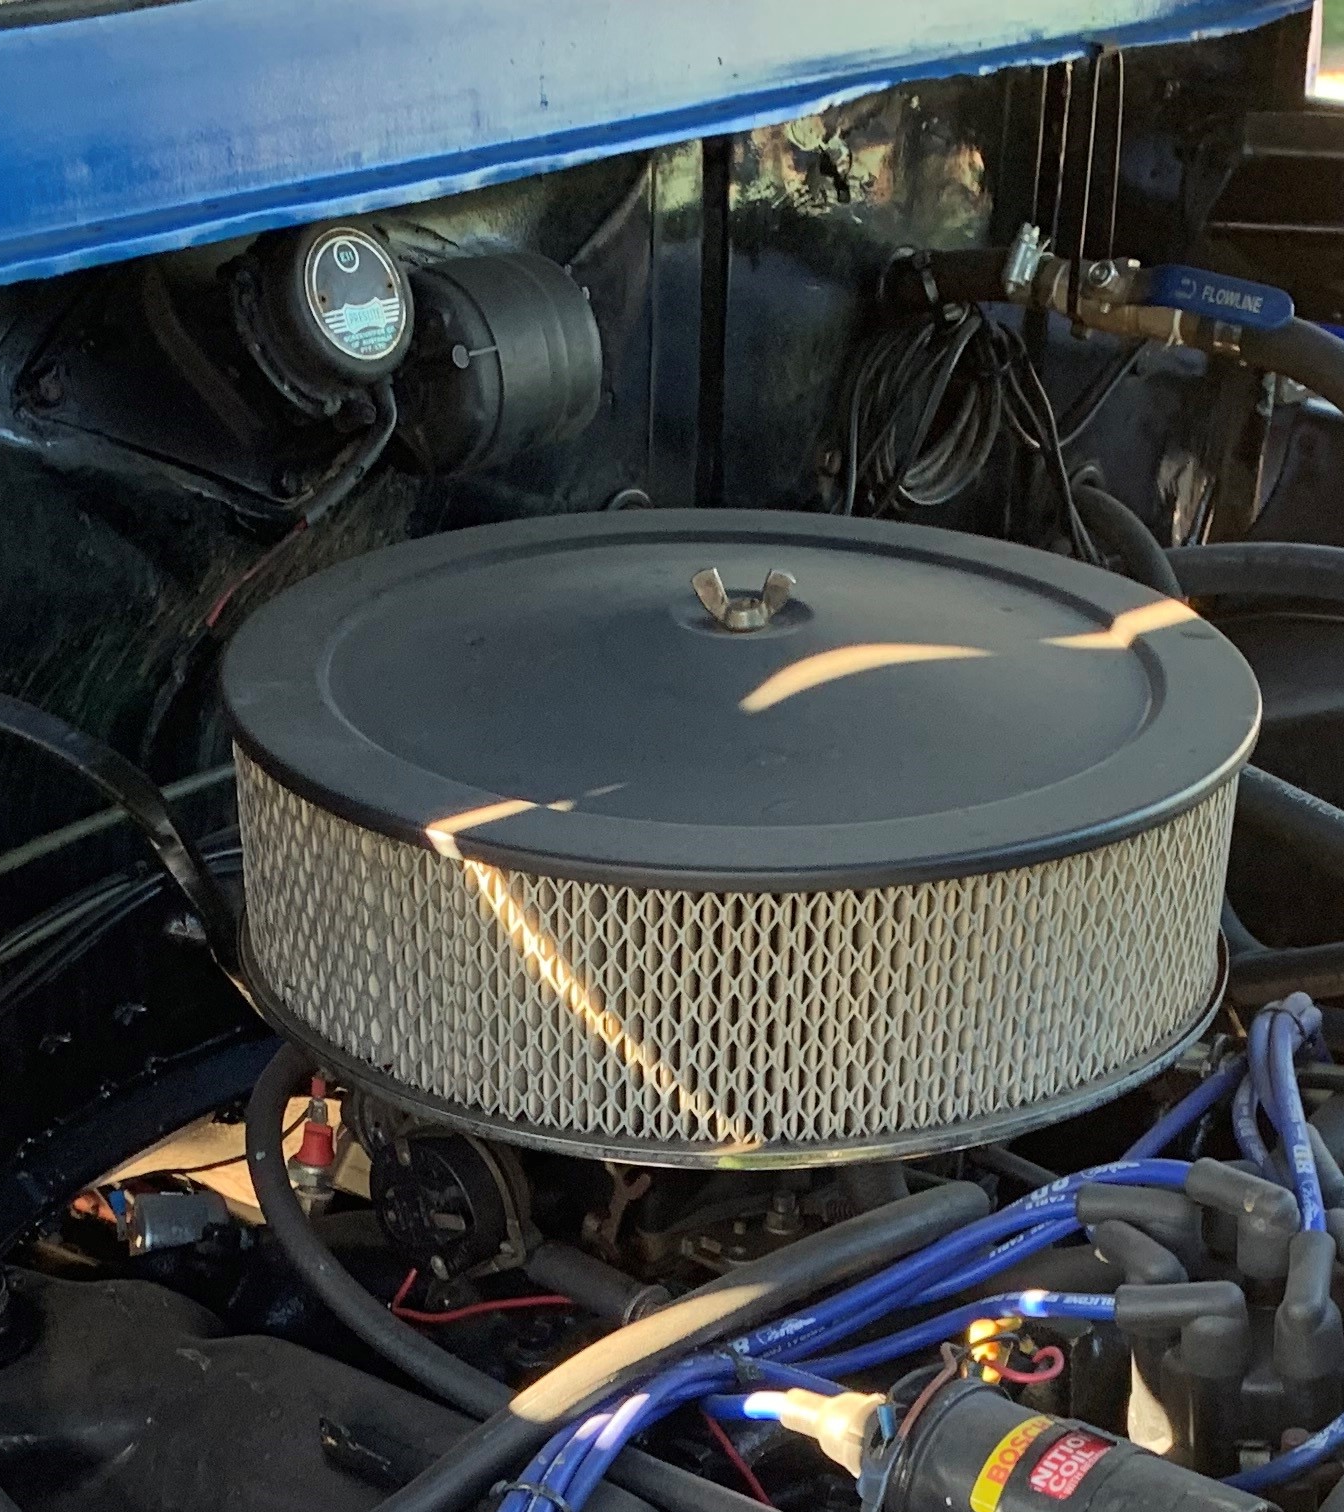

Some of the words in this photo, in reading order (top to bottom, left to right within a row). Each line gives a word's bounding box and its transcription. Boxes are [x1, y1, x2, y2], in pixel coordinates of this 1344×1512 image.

[1201, 284, 1264, 314] FLOWLINE
[986, 1419, 1048, 1485] BOSCH
[1048, 1448, 1096, 1492] COIL
